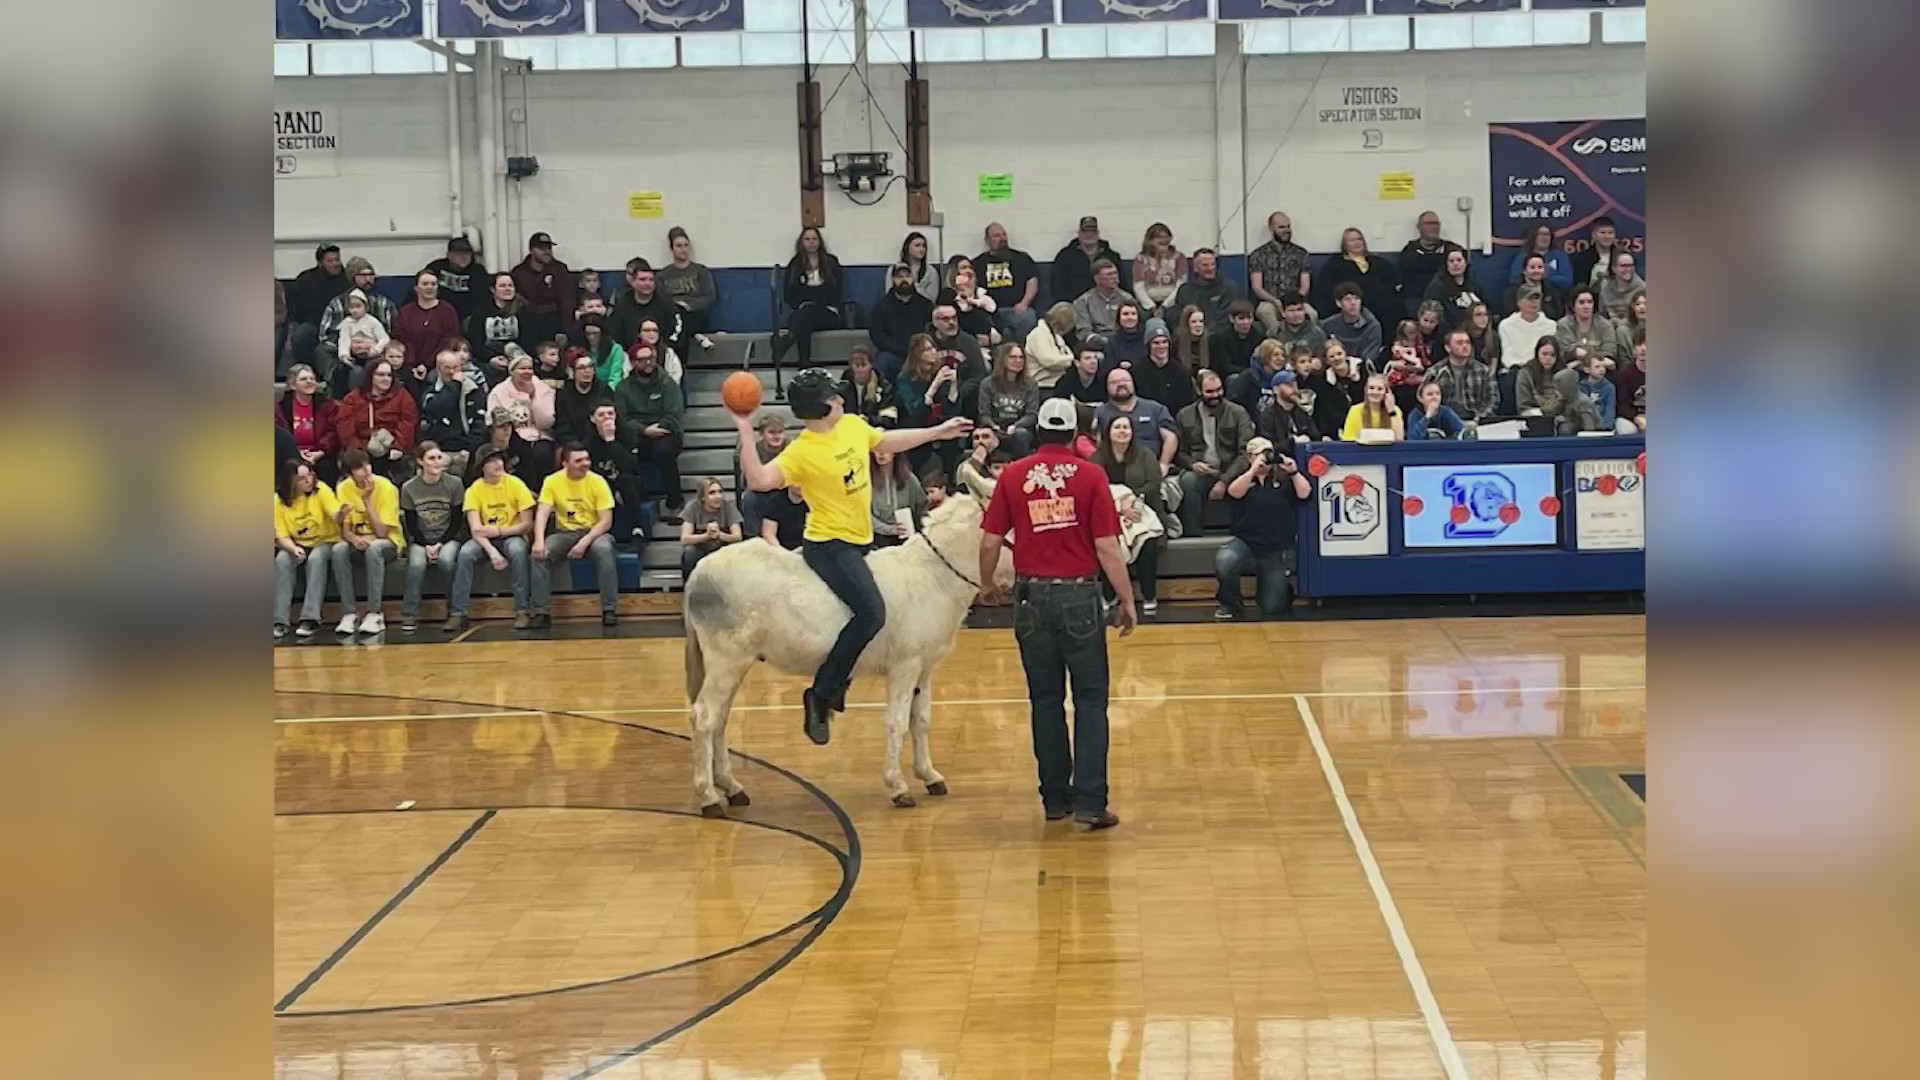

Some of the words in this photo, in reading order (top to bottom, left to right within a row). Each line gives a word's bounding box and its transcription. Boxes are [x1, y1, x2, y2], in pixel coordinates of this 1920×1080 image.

[1342, 87, 1398, 105] VISITORS
[1320, 109, 1377, 122] SPECTATOR
[1380, 107, 1422, 121] SECTION
[278, 136, 335, 149] SECTION
[1610, 137, 1646, 152] SSM
[1508, 175, 1529, 187] For
[1532, 175, 1565, 186] when
[1508, 192, 1532, 205] you
[1534, 191, 1566, 203] can't
[1508, 206, 1537, 218] walk
[1540, 206, 1550, 218] it
[1552, 204, 1571, 218] off
